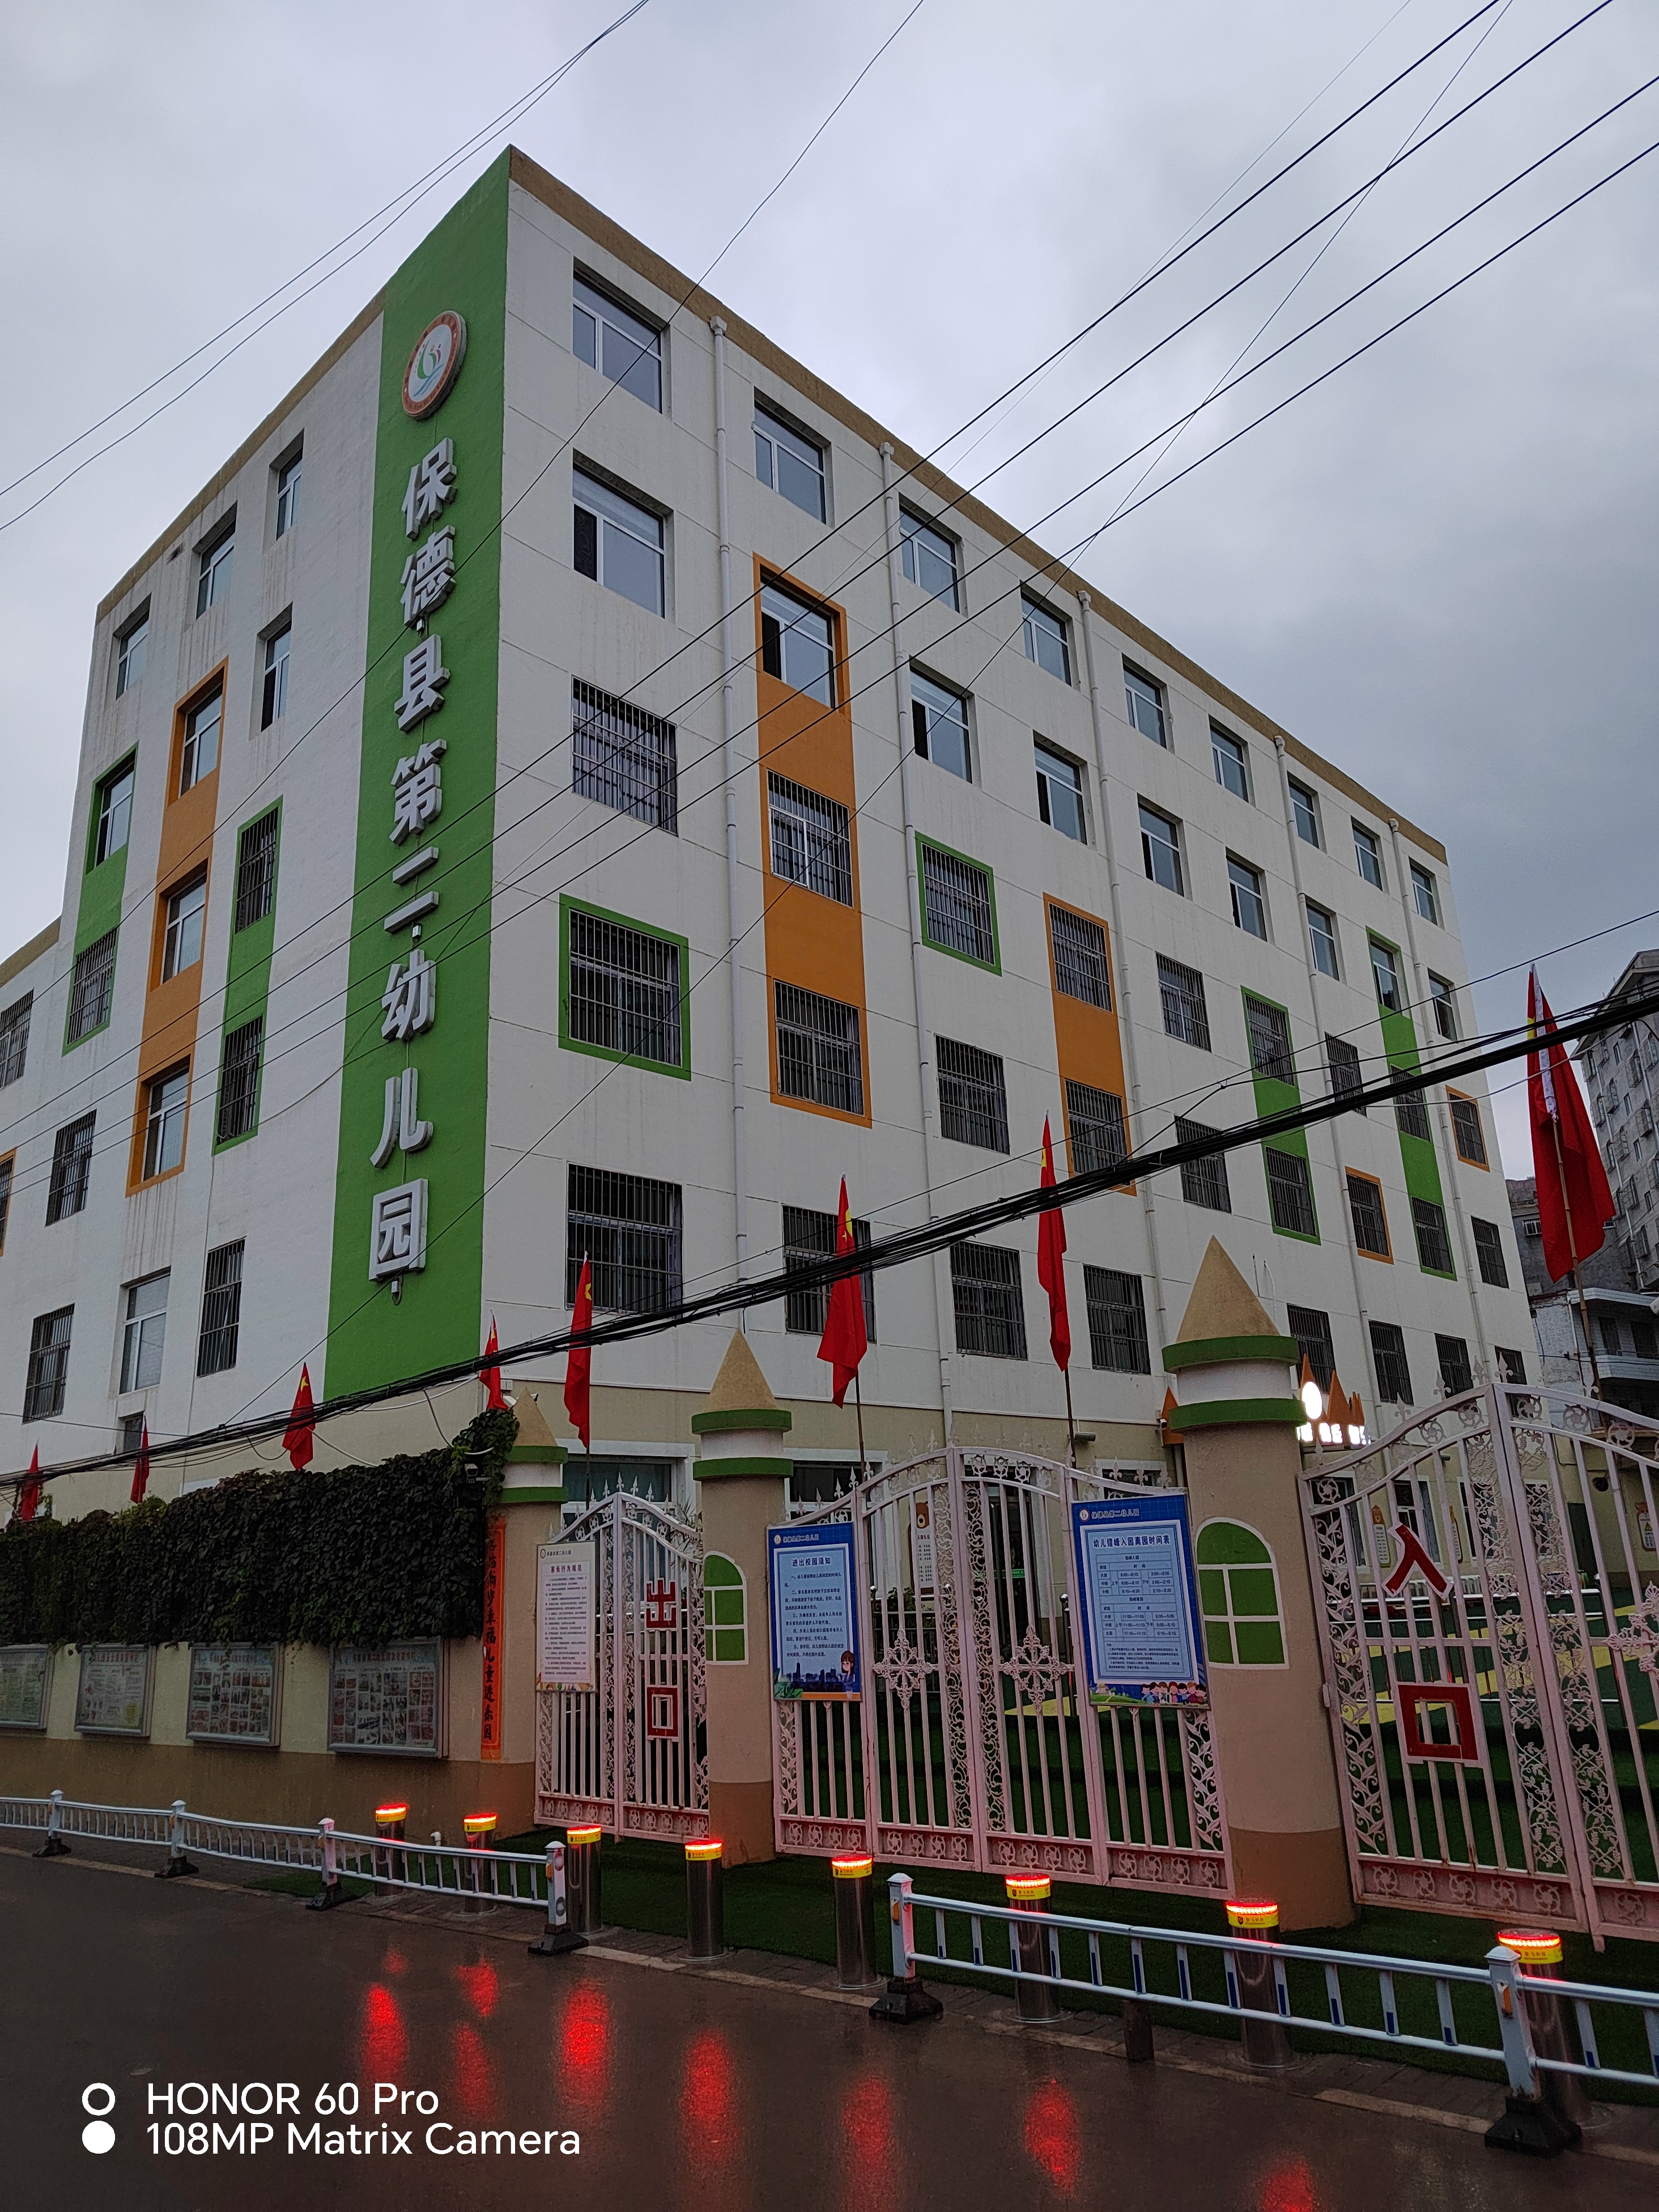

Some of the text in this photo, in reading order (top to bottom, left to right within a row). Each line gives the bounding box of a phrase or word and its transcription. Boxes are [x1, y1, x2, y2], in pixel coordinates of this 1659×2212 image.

[369, 437, 457, 1281] 保德县第二幼儿园
[1091, 1509, 1139, 1519] 保德县第二幼儿园
[1093, 1534, 1170, 1548] 幼儿错峰入园离园时间表
[792, 1557, 831, 1567] 进出校园须知
[646, 1579, 678, 1737] 出口
[1386, 1524, 1478, 1760] 入口
